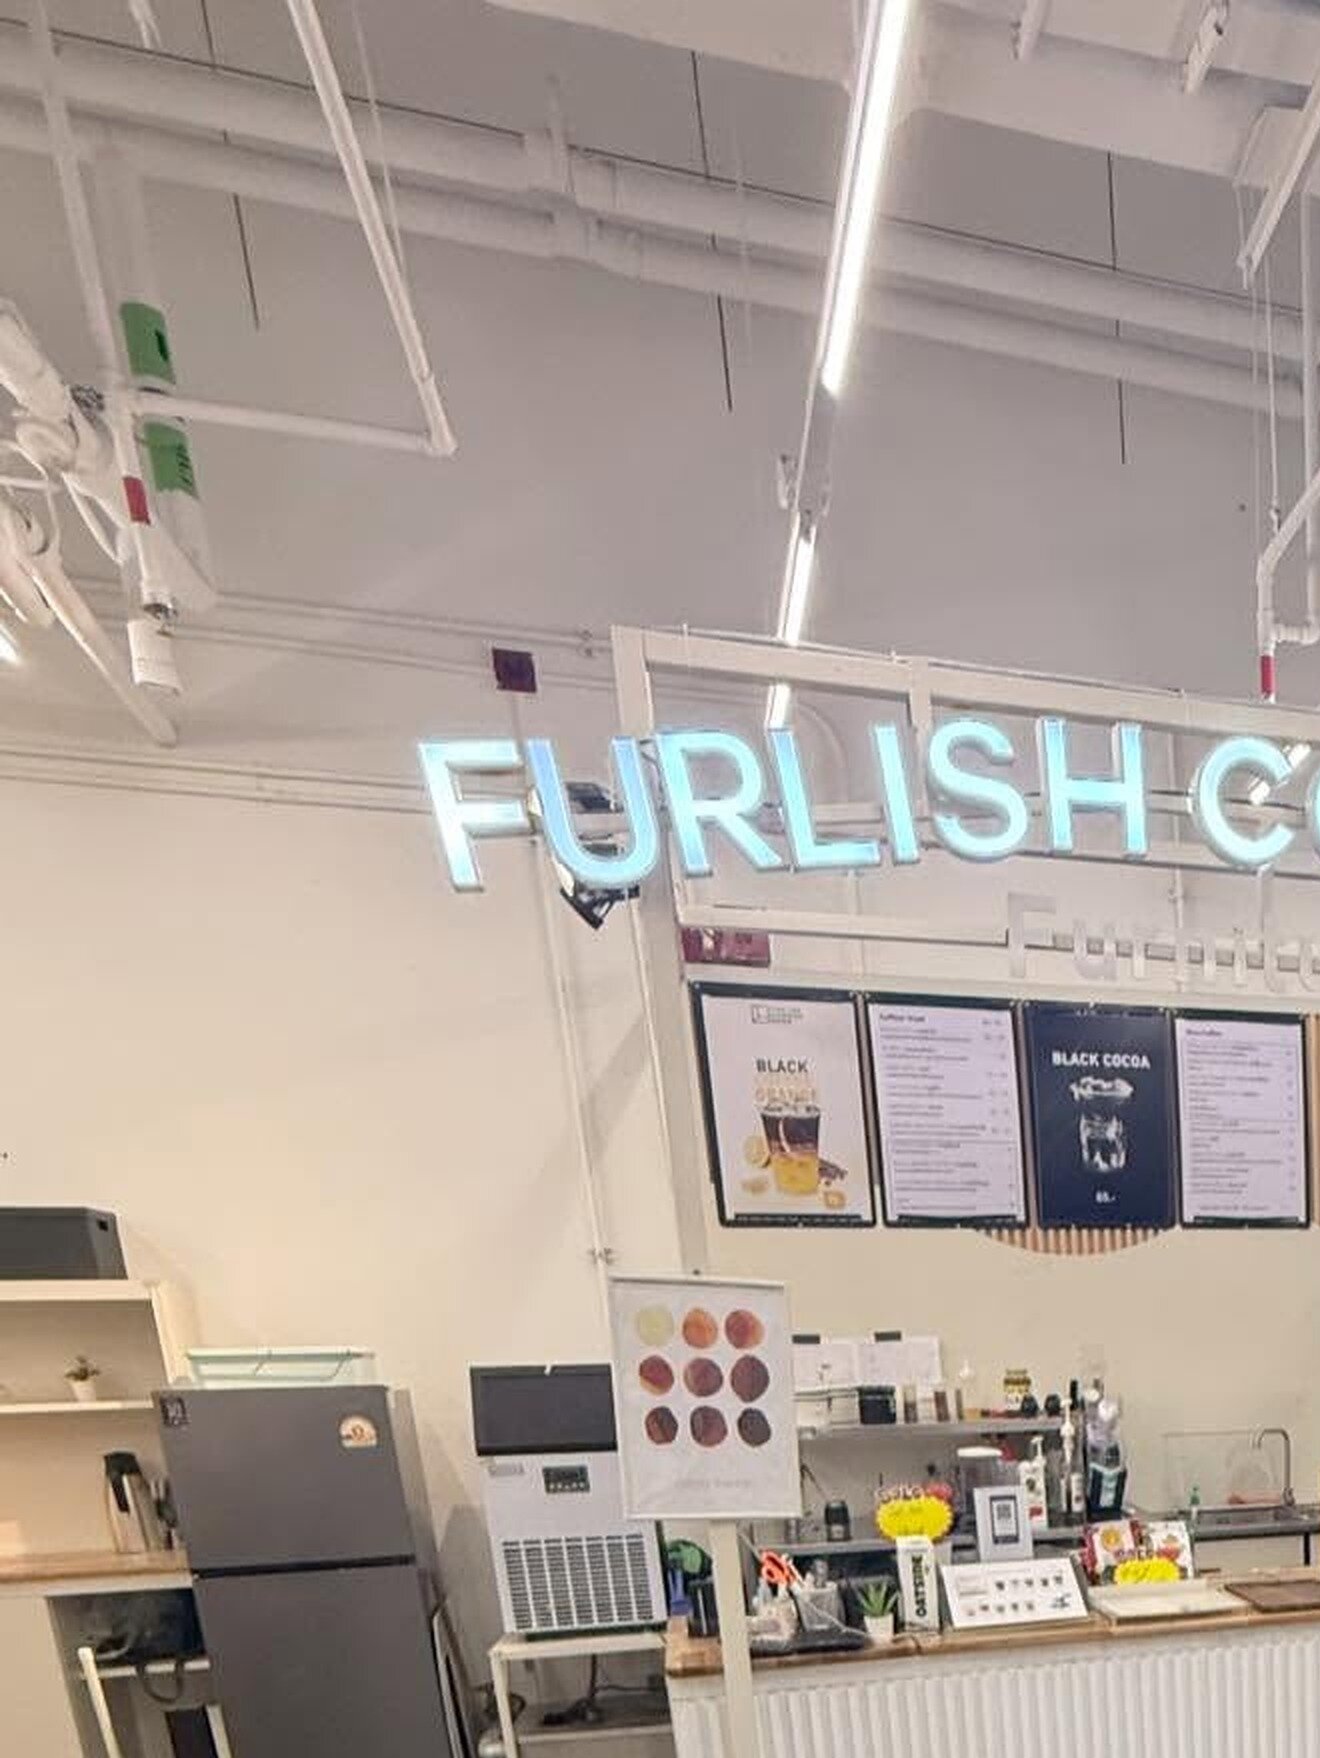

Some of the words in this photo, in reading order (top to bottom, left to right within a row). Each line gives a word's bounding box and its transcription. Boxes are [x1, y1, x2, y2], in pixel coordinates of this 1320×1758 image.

[414, 716, 1149, 892] FURLISH
[756, 1058, 809, 1074] BLACK
[1052, 1051, 1099, 1067] BLACK
[1103, 1053, 1151, 1070] COCOA
